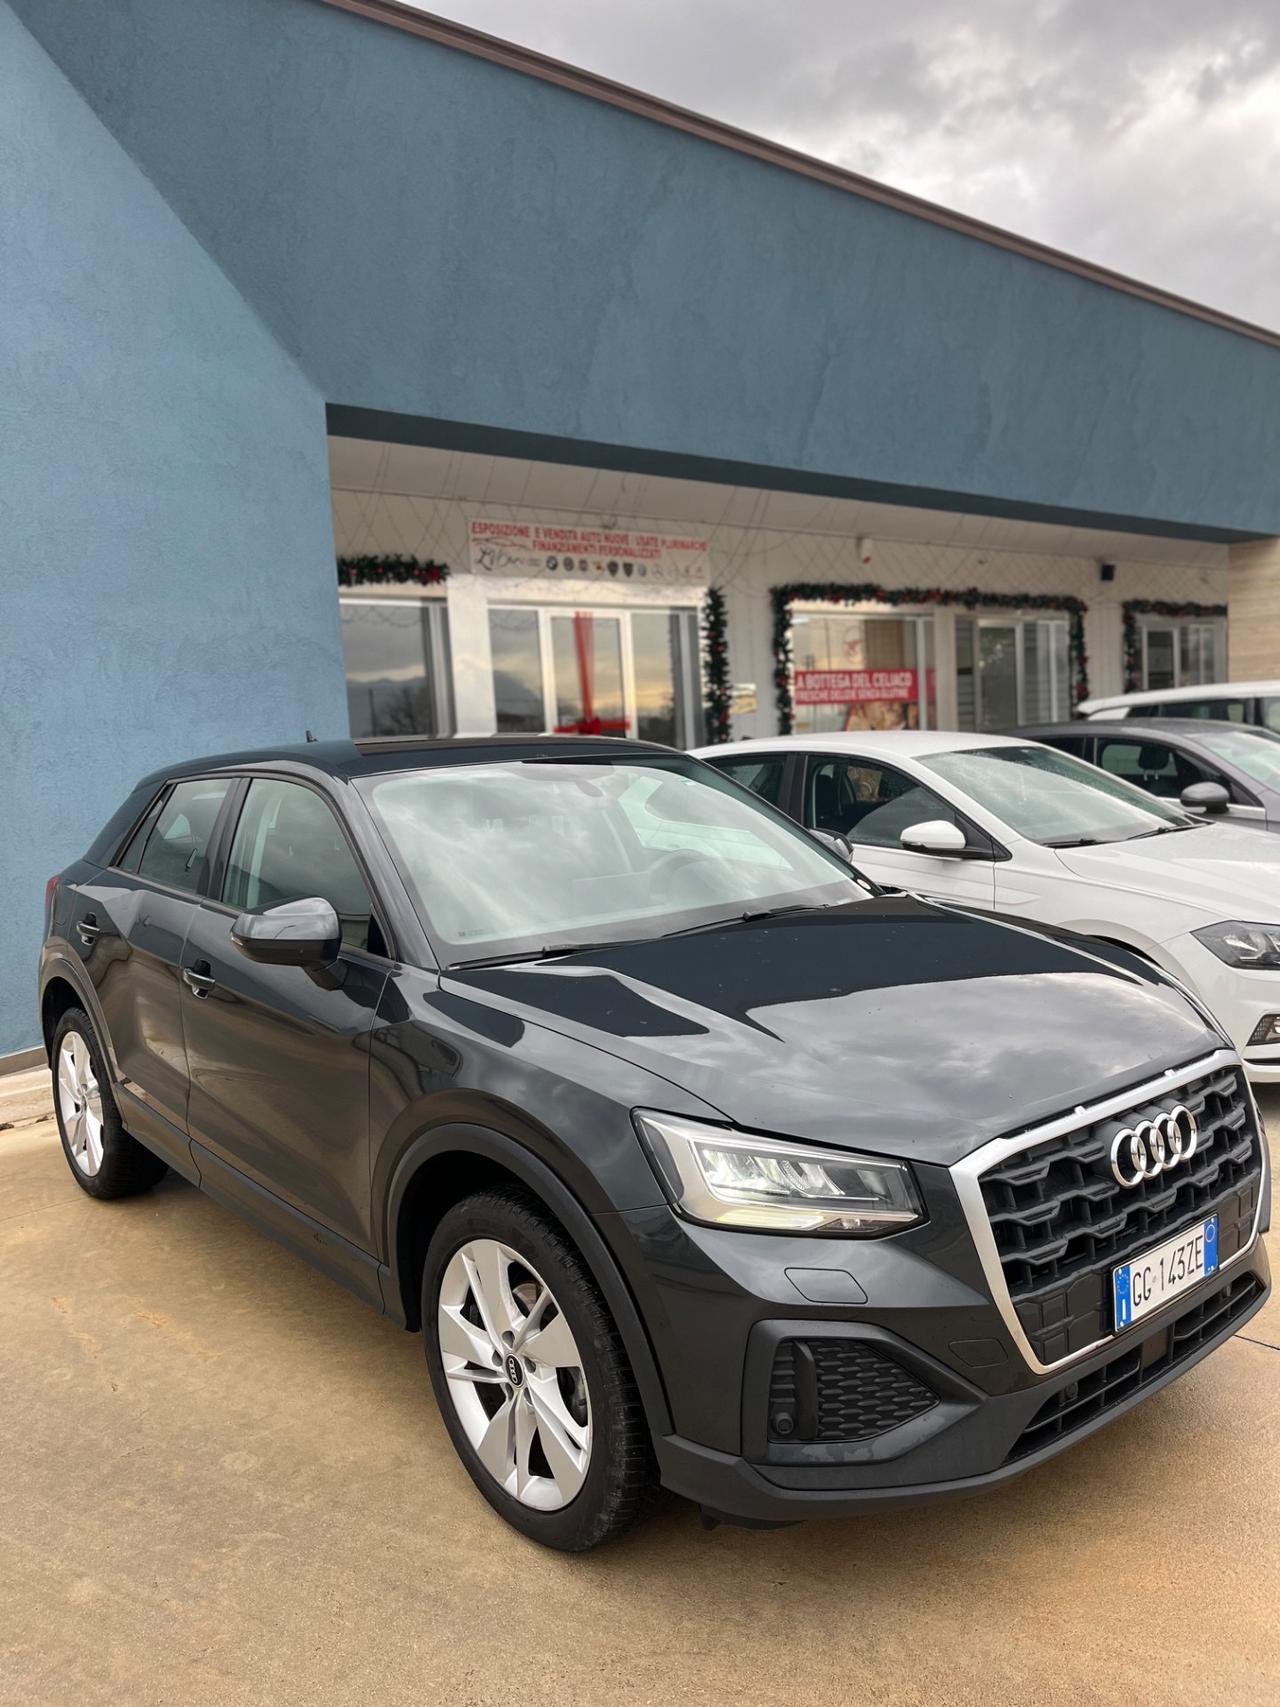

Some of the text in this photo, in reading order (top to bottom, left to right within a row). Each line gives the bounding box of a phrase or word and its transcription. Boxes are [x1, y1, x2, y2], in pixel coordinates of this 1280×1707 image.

[472, 521, 530, 538] ESPOSIZIONE
[543, 527, 578, 541] VENDITA
[580, 530, 602, 543] AUTO
[603, 533, 630, 546] NUOVE
[635, 535, 659, 547] USATE
[532, 539, 661, 559] FINANZIAMENTI PERSONALIZZATI
[805, 673, 851, 689] BOTTEGA
[851, 672, 872, 688] DEL
[872, 671, 913, 687] CELIACO
[1132, 1265, 1152, 1307] GG
[1159, 1234, 1204, 1291] 143ZE
